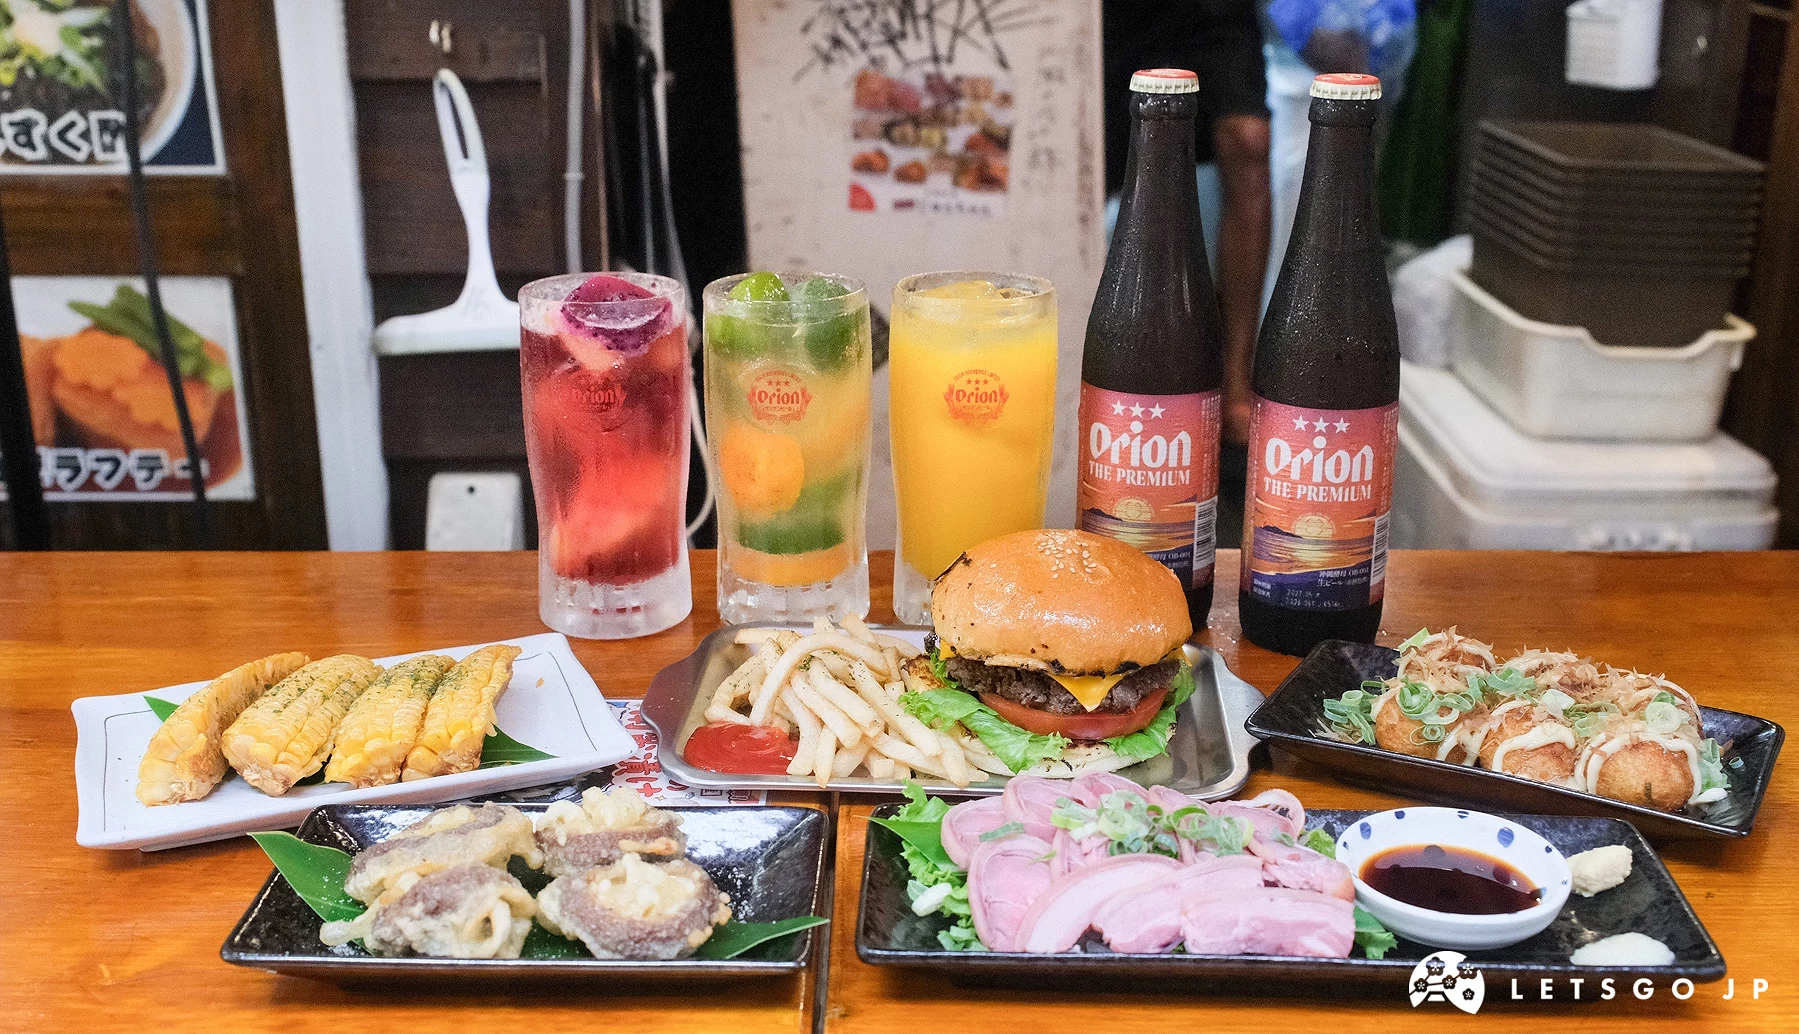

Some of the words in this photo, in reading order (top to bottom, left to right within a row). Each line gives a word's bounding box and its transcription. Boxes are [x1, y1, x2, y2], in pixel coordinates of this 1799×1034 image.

[757, 387, 800, 405] Orion
[955, 387, 998, 404] Orion
[1089, 420, 1192, 469] Orion
[36, 446, 209, 492] ラフテー
[1265, 435, 1374, 484] Orion
[1089, 460, 1112, 481] THE
[1116, 468, 1191, 487] PREMIUM
[1263, 476, 1292, 499] THE
[1296, 484, 1372, 502] PREMIUM
